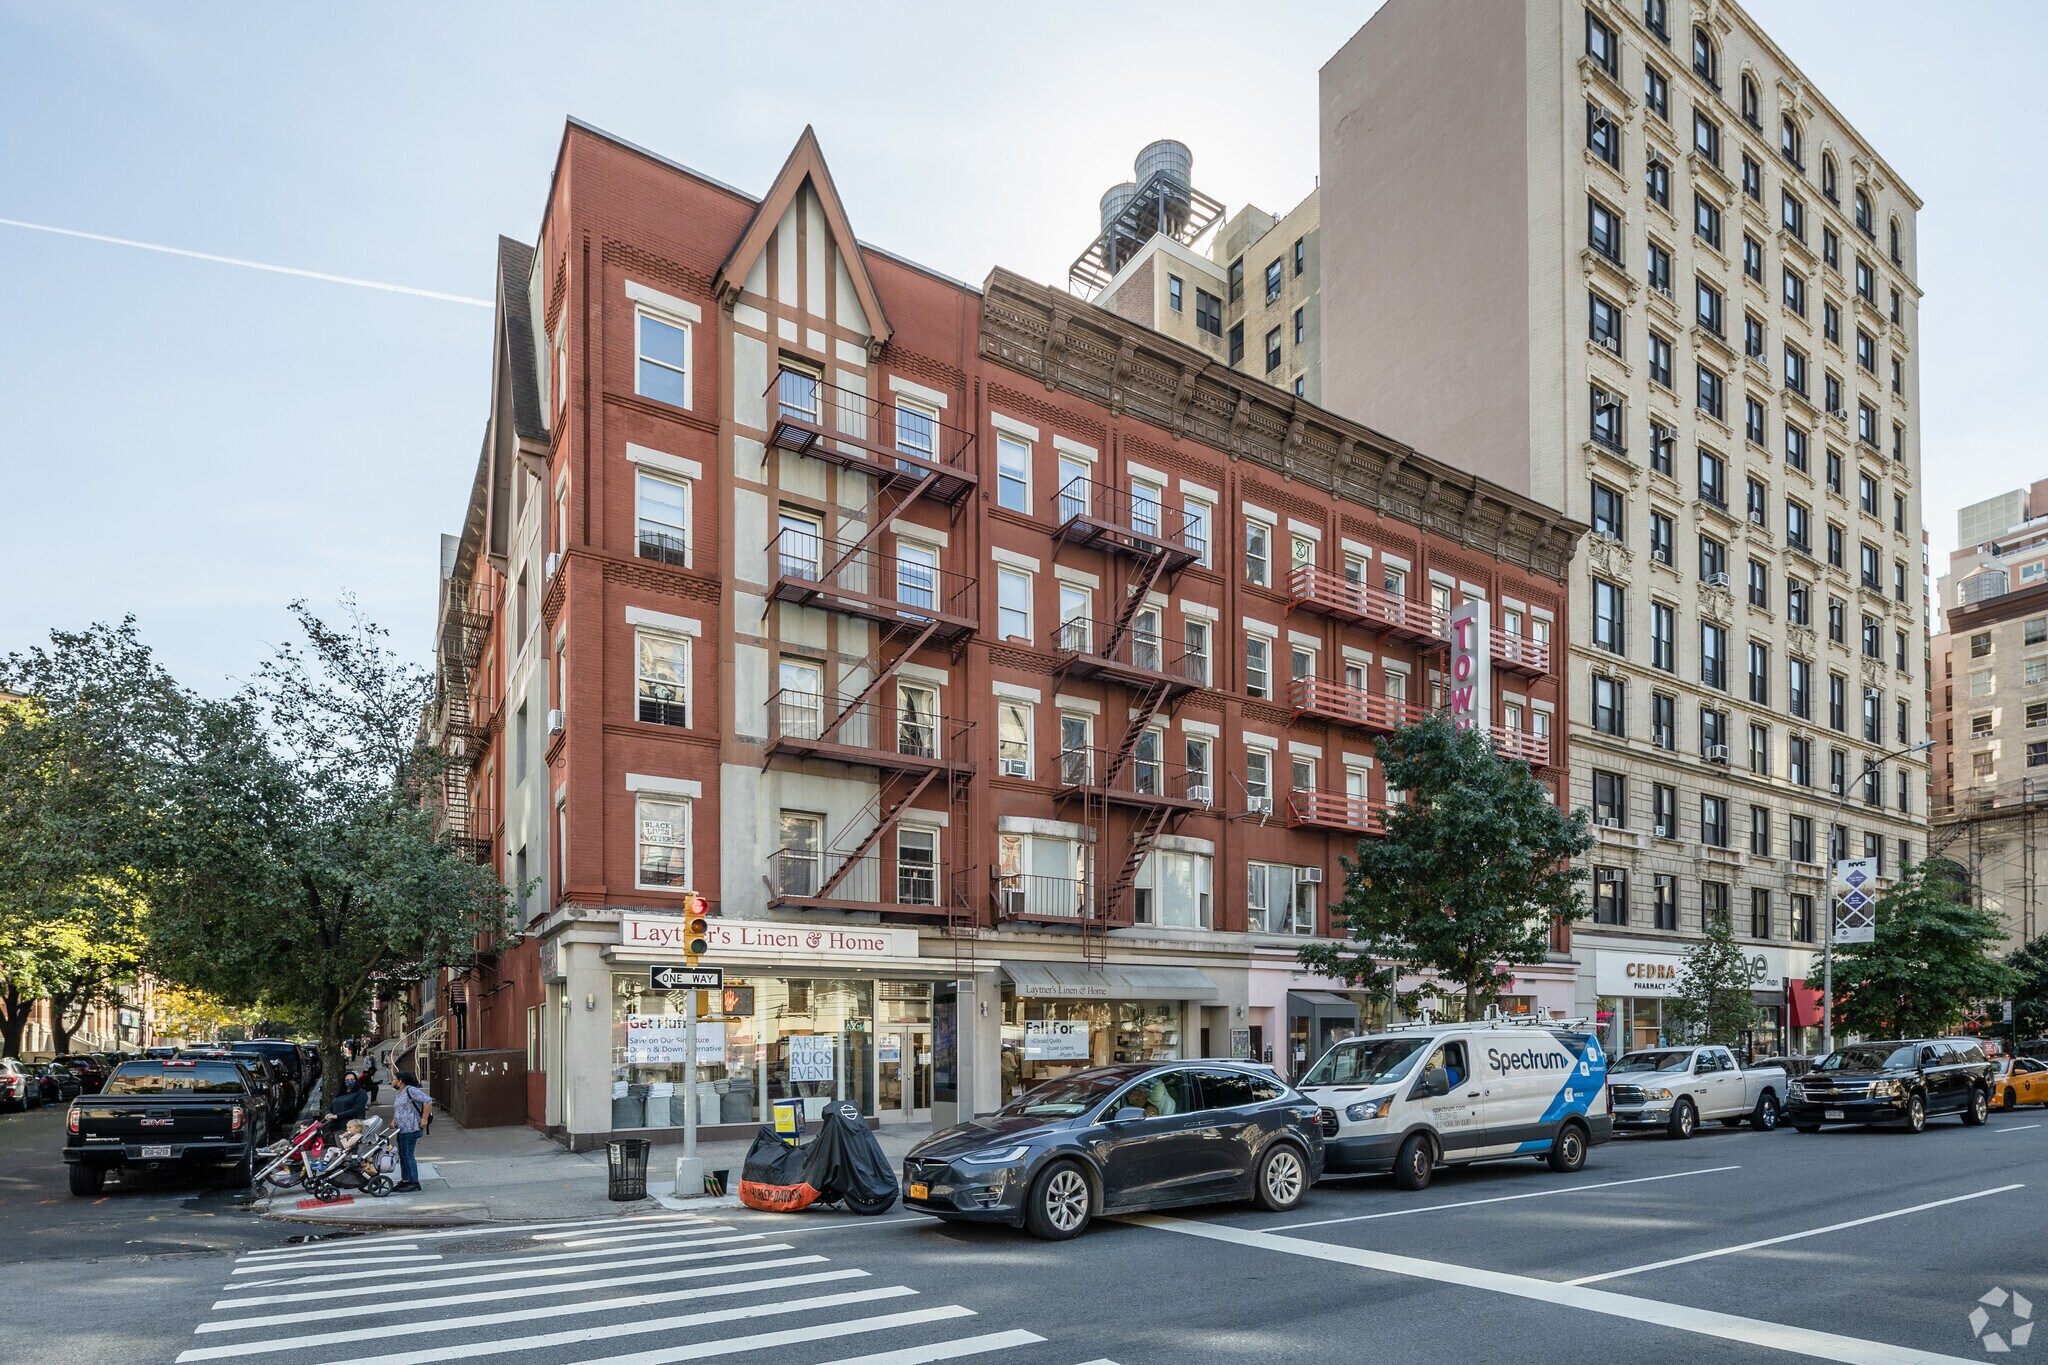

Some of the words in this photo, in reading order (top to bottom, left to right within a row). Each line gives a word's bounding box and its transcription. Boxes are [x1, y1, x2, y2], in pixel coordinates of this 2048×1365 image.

[632, 922, 731, 946] Laytr's
[740, 927, 799, 947] Linen
[805, 931, 822, 949] &
[828, 932, 885, 951] Home
[1626, 962, 1676, 979] CEDRA
[662, 973, 683, 983] ONE
[692, 974, 714, 984] WAY
[1026, 985, 1057, 995] Laytner's
[1058, 985, 1078, 995] Linen
[1079, 986, 1086, 995] &
[1087, 986, 1107, 995] Home
[1633, 982, 1666, 990] PHARMACY
[629, 1017, 653, 1029] Get
[1025, 1021, 1049, 1035] Fall
[1053, 1021, 1075, 1035] For
[792, 1036, 832, 1050] AREA
[791, 1051, 832, 1066] RUGS
[1487, 1048, 1564, 1076] Spectrum
[791, 1066, 832, 1080] EVENT
